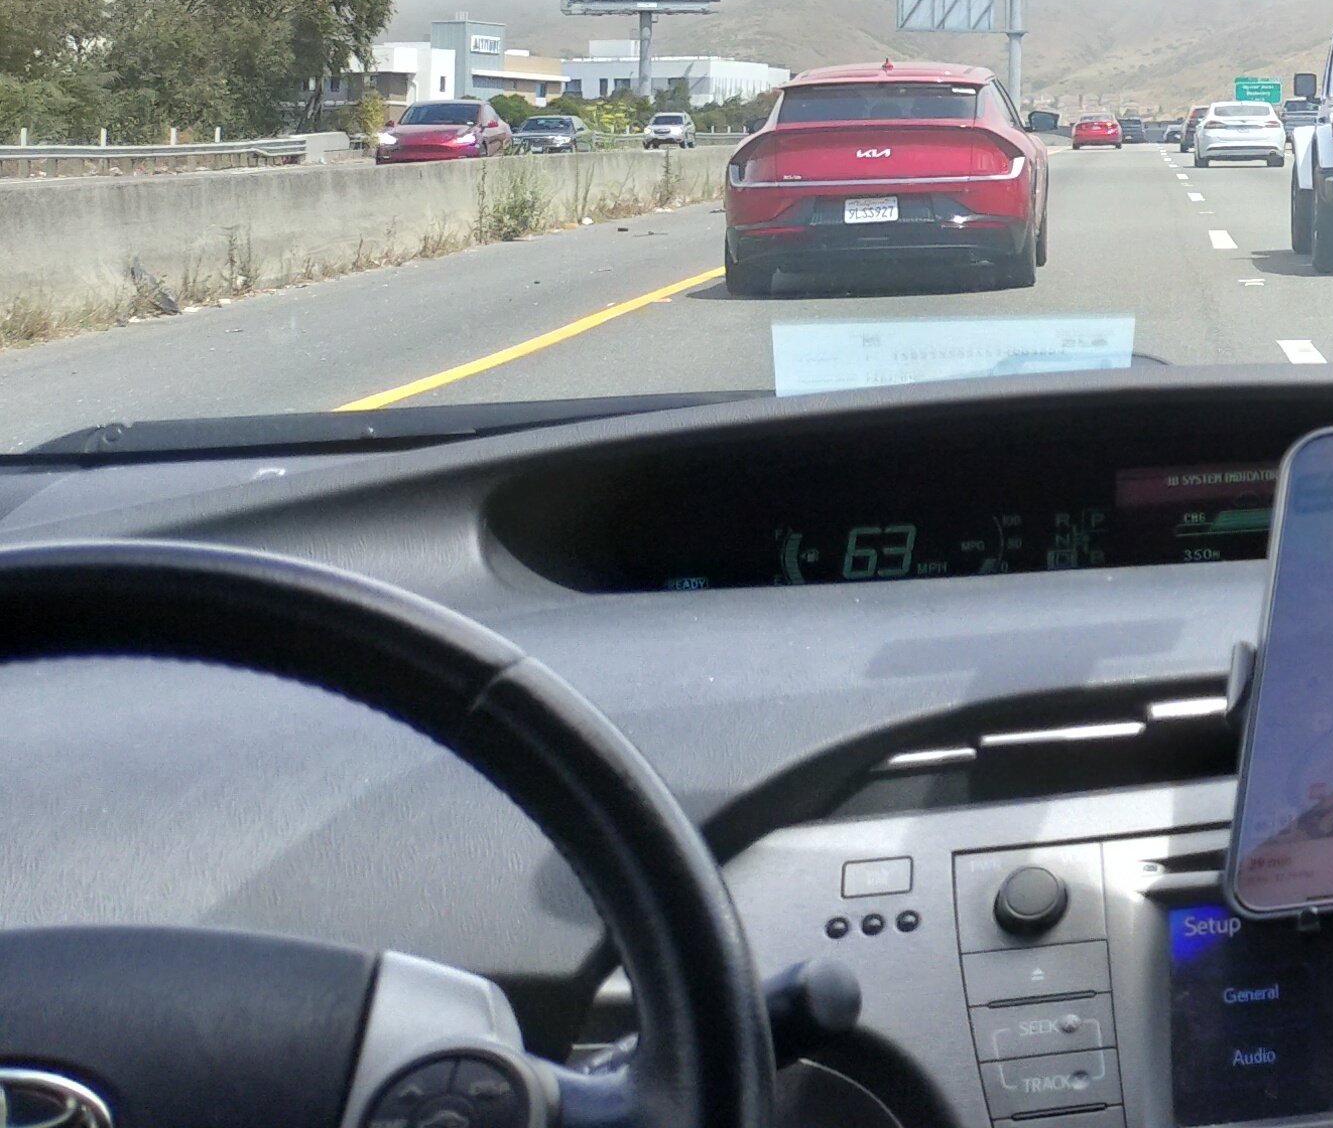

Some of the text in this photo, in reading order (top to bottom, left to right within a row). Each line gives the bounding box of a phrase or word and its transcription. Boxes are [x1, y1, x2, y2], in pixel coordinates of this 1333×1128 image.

[842, 524, 917, 579] 63
[917, 562, 948, 574] MPH
[1184, 917, 1242, 938] Setup
[1224, 984, 1279, 1004] General
[1232, 1048, 1276, 1067] Audio
[1024, 1075, 1071, 1093] TRACK
